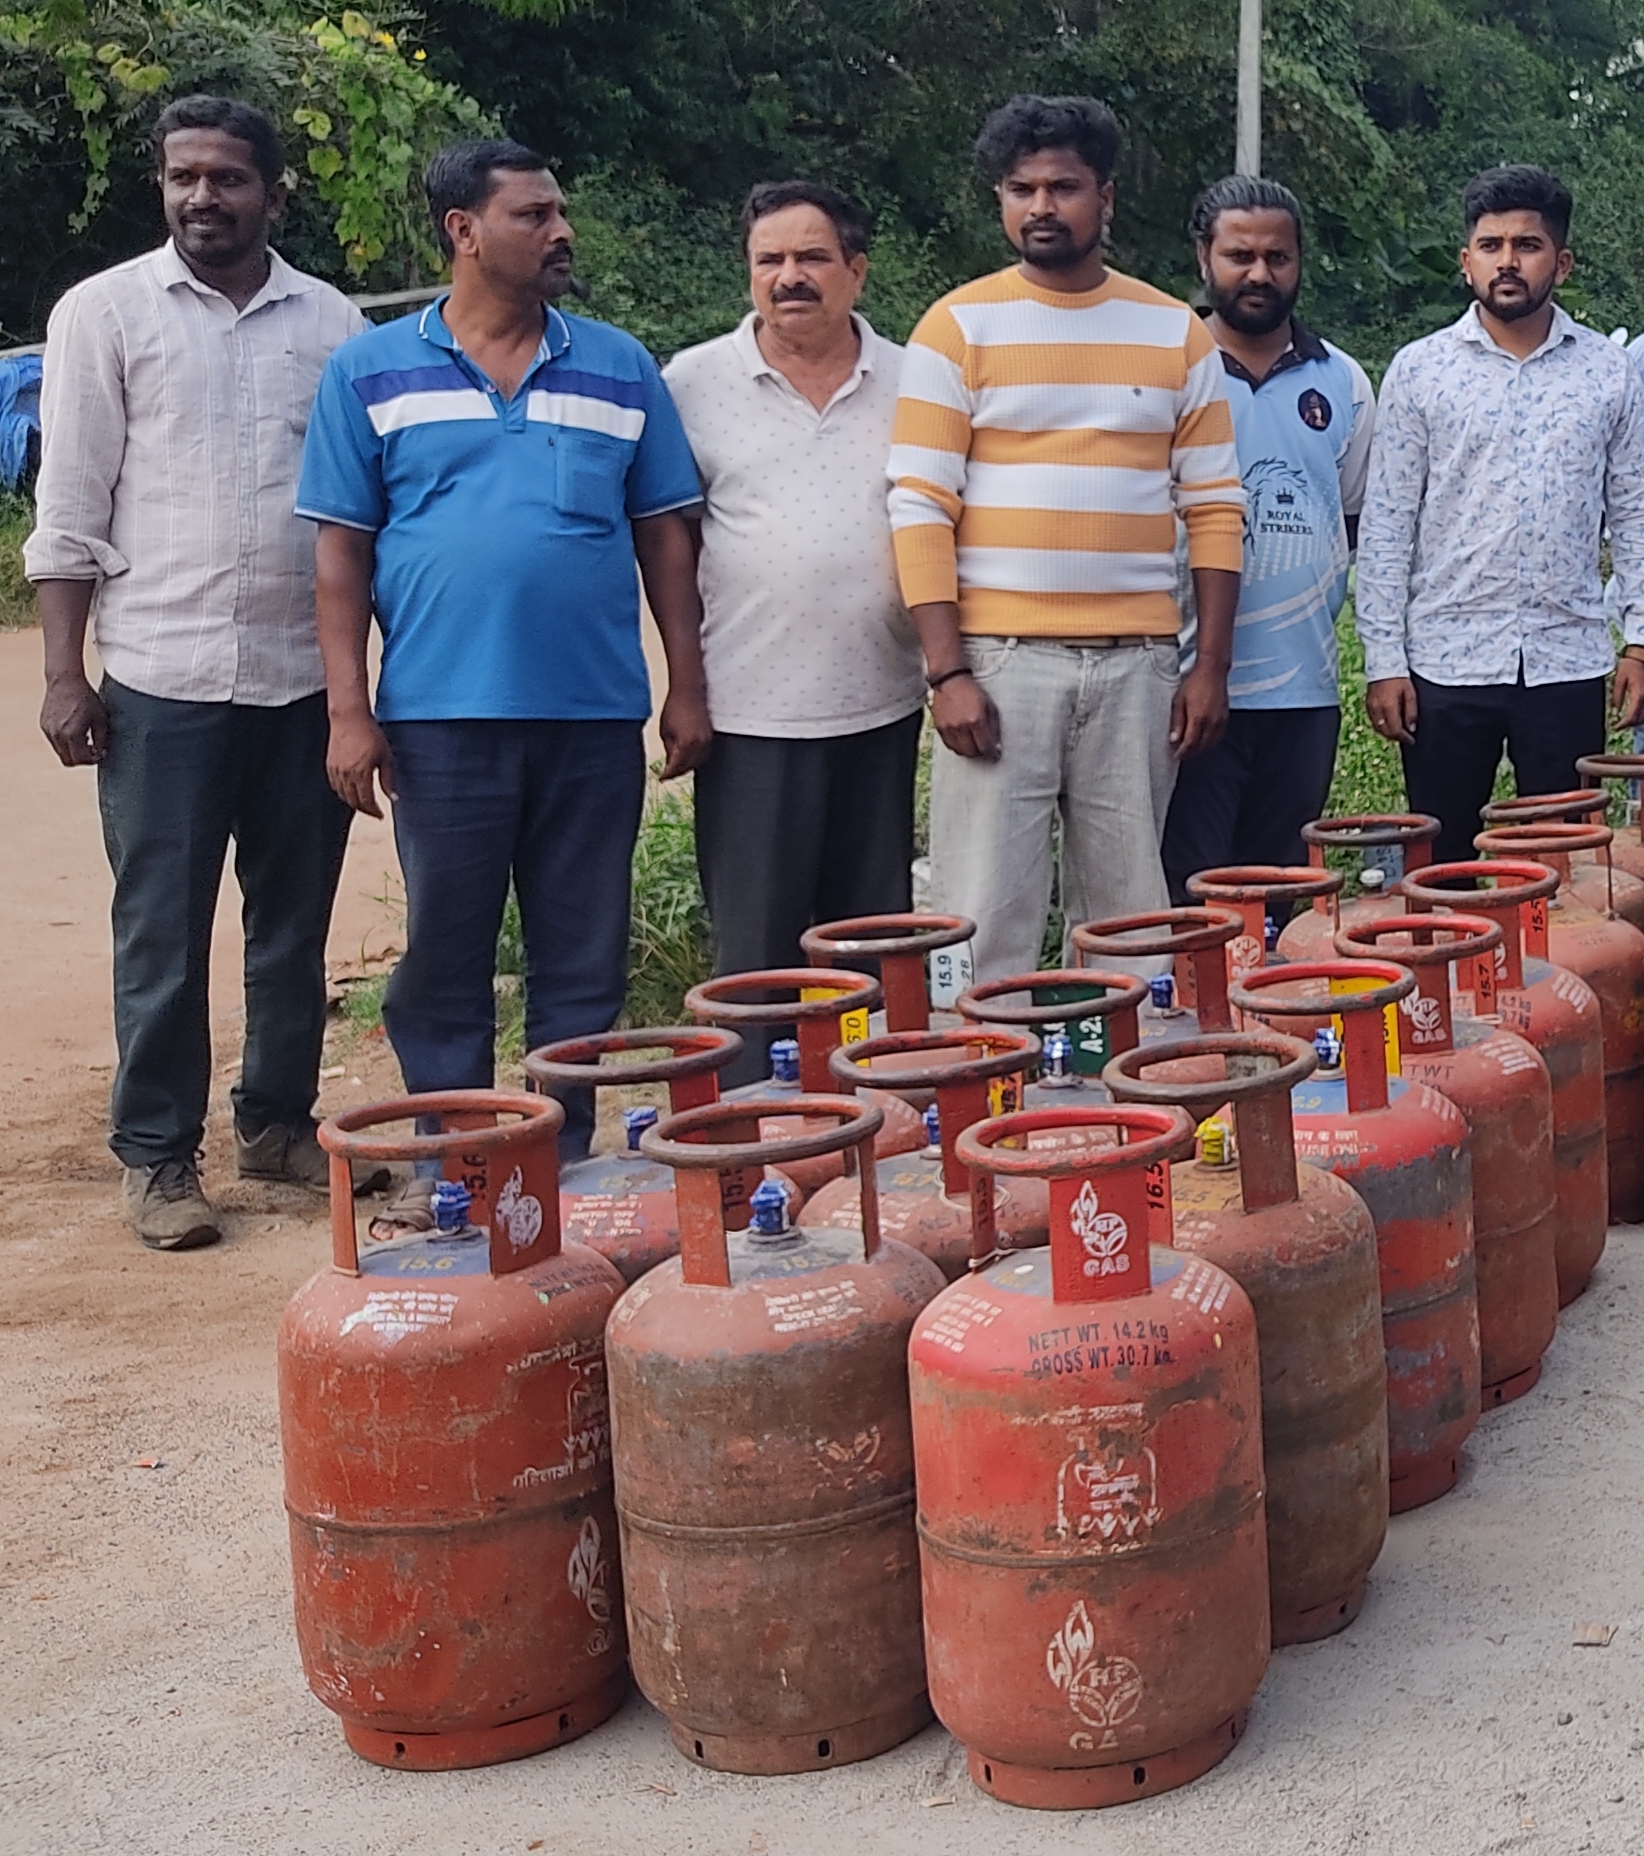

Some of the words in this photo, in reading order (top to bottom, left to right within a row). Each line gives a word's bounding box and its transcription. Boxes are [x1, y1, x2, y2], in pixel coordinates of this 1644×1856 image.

[1267, 510, 1306, 522] ROYAL
[937, 954, 953, 989] 15.9
[1478, 963, 1492, 999] 15.7
[1146, 1162, 1164, 1209] 16.5
[1083, 1254, 1130, 1276] GAS
[1028, 1327, 1071, 1354] NETT
[1113, 1320, 1146, 1341] 14.2
[1149, 1319, 1169, 1344] kg
[1032, 1345, 1084, 1375] GROSS
[1117, 1344, 1149, 1367] 30.7
